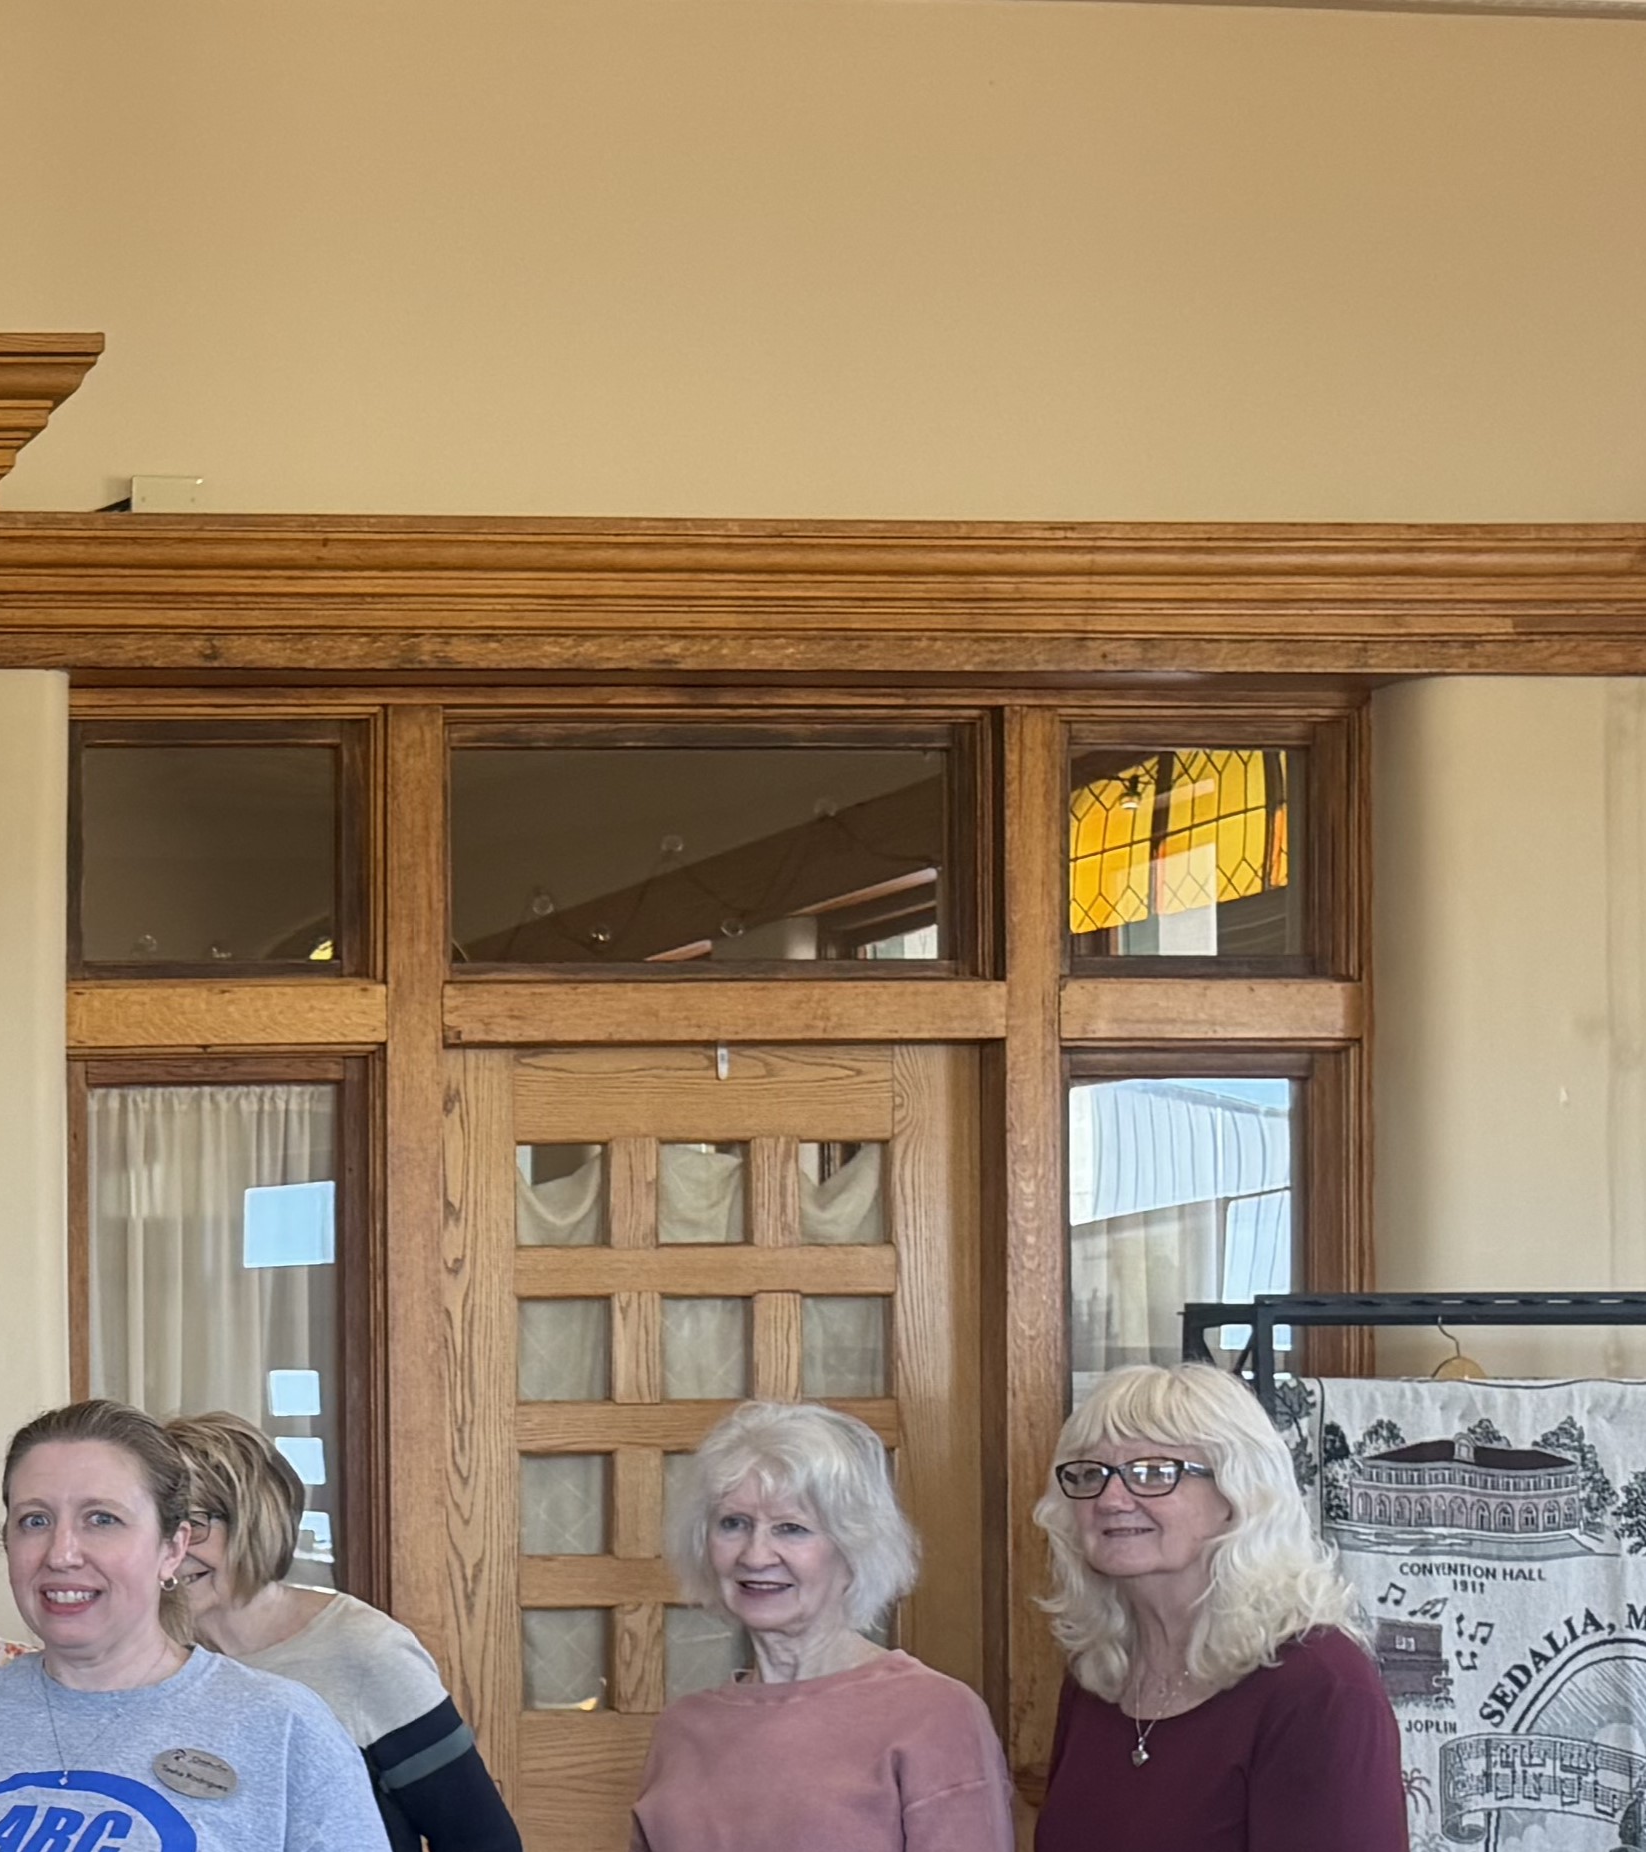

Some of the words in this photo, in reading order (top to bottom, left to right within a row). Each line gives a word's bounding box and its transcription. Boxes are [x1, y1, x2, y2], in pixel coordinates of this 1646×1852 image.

[1399, 1562, 1497, 1580] CONVENTION
[1502, 1566, 1547, 1582] HALL
[1452, 1579, 1486, 1594] 1911
[1478, 1607, 1617, 1728] SEDALIA,
[1405, 1719, 1457, 1734] JOPLIN
